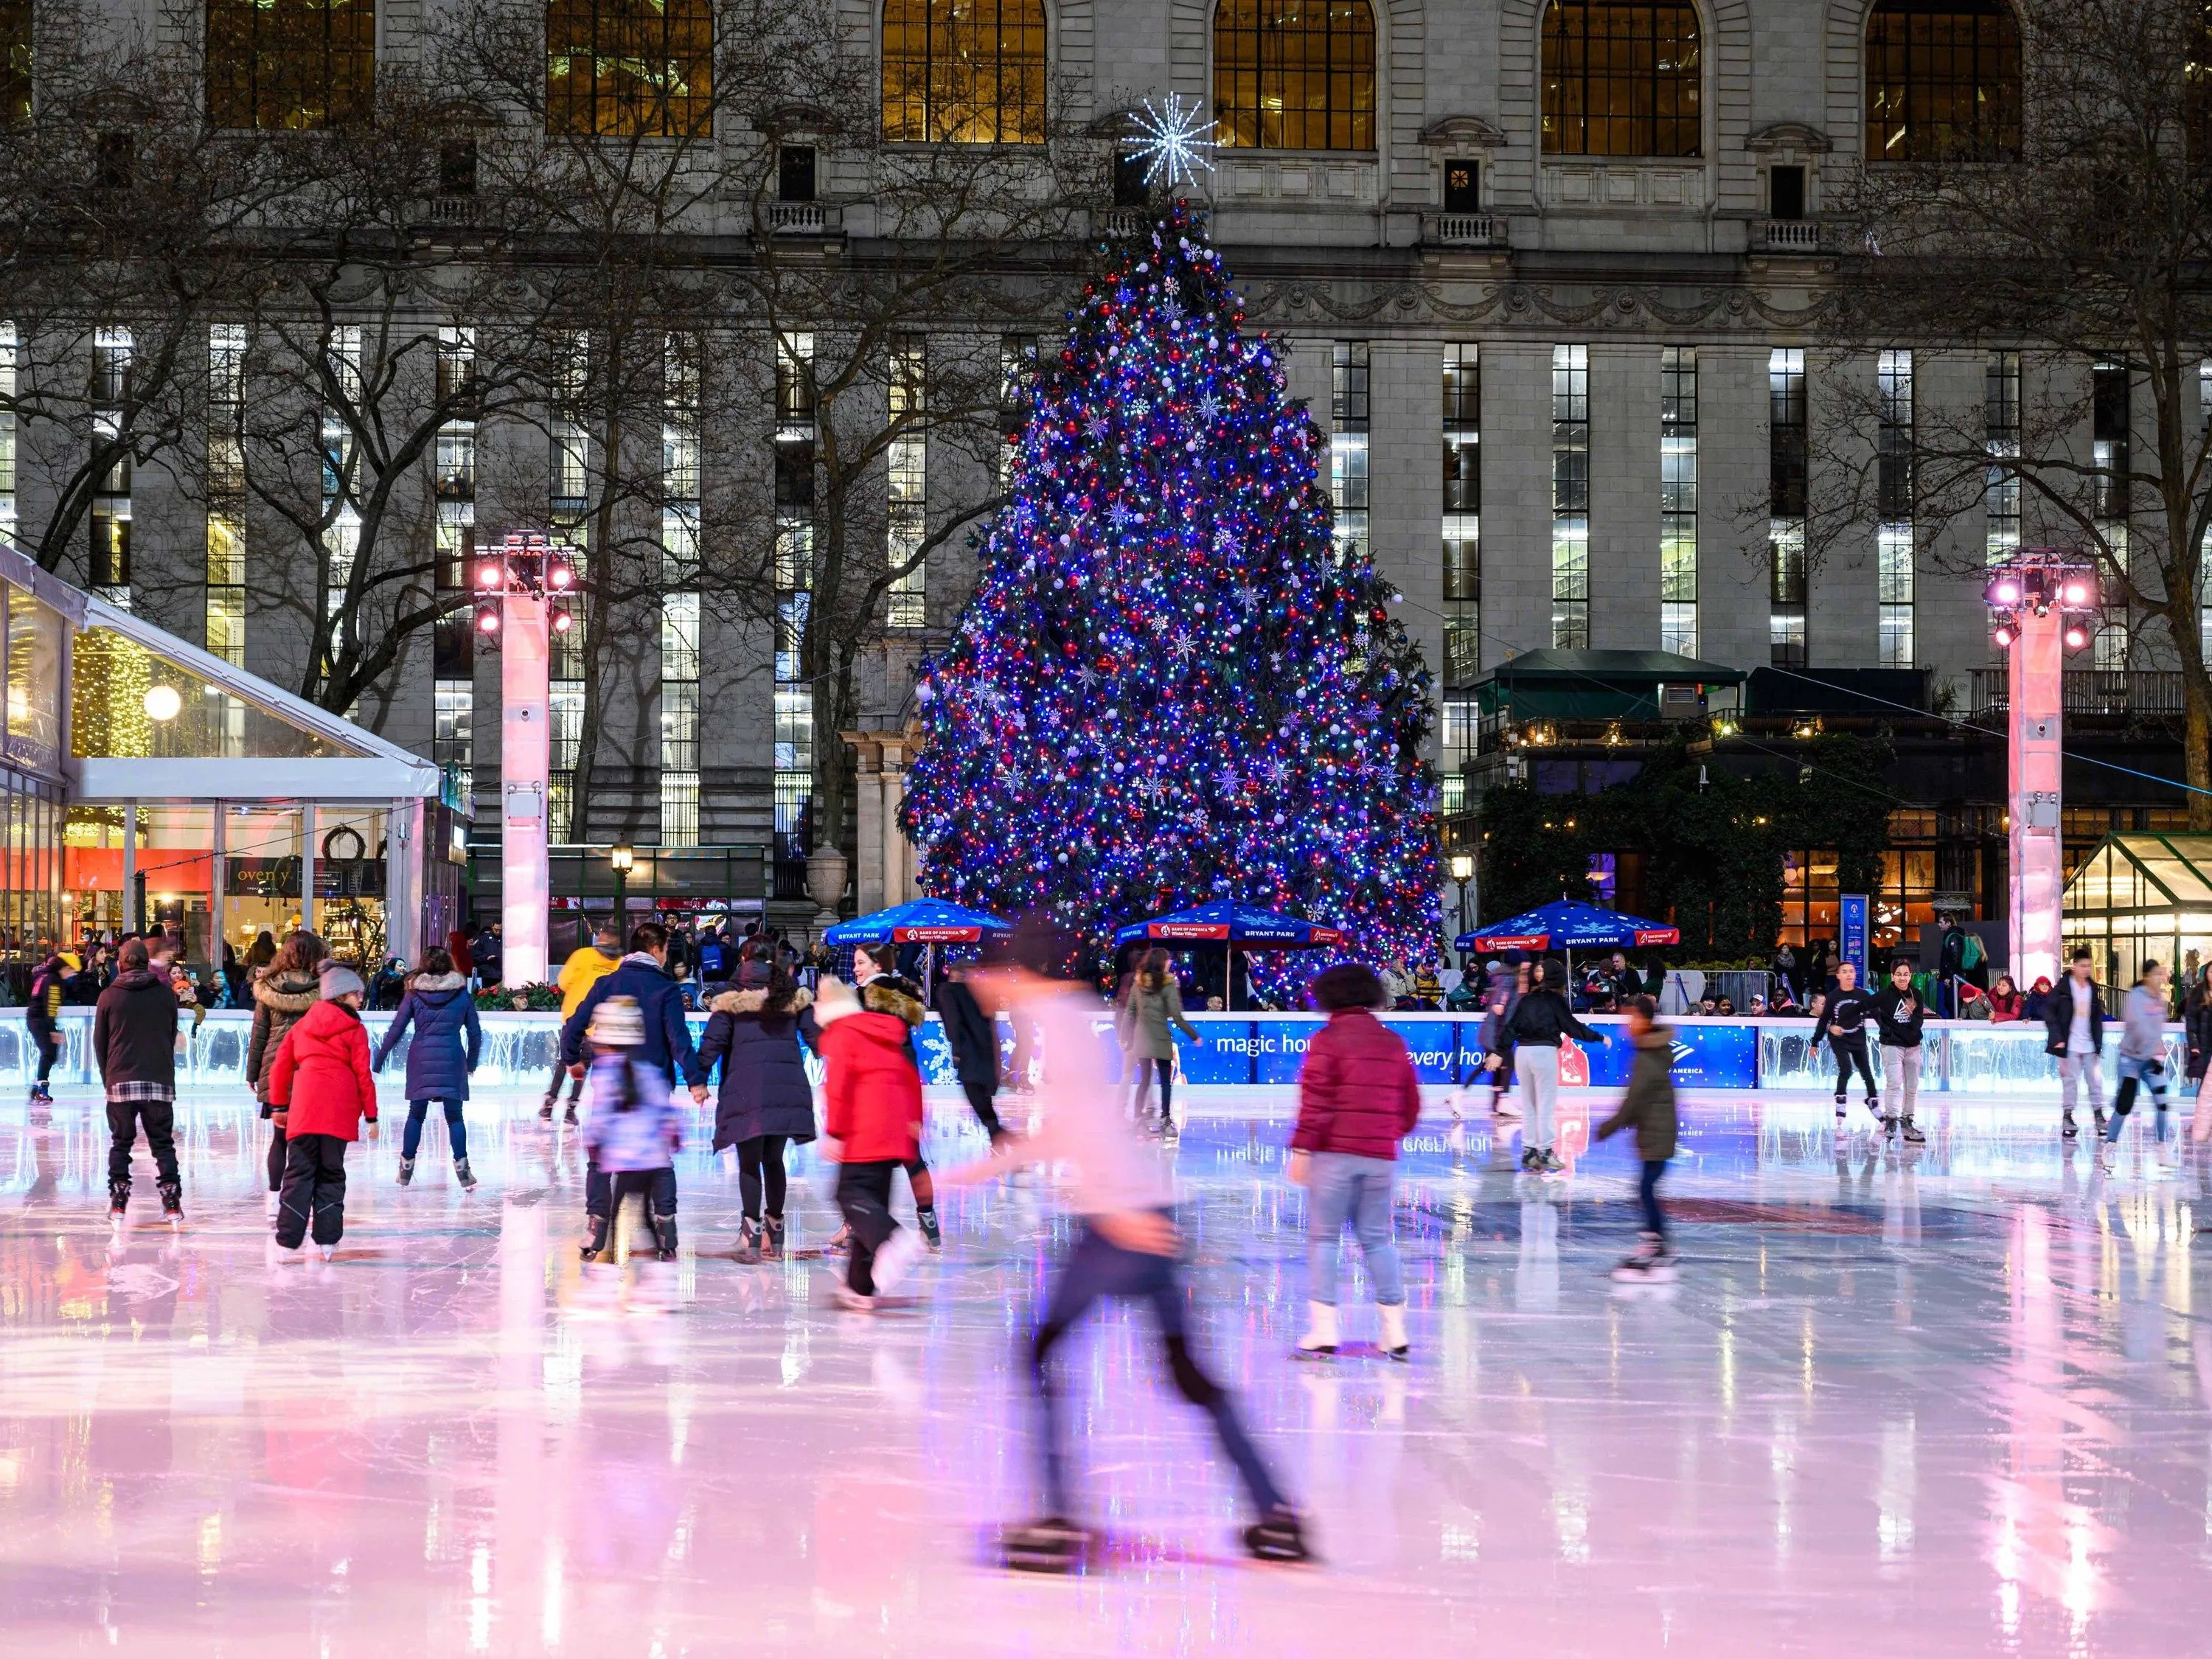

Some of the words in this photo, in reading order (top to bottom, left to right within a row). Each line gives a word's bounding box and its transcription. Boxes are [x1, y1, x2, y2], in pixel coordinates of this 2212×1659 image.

[237, 870, 289, 886] oveny
[1217, 1034, 1276, 1057] magic
[1405, 1051, 1453, 1070] every
